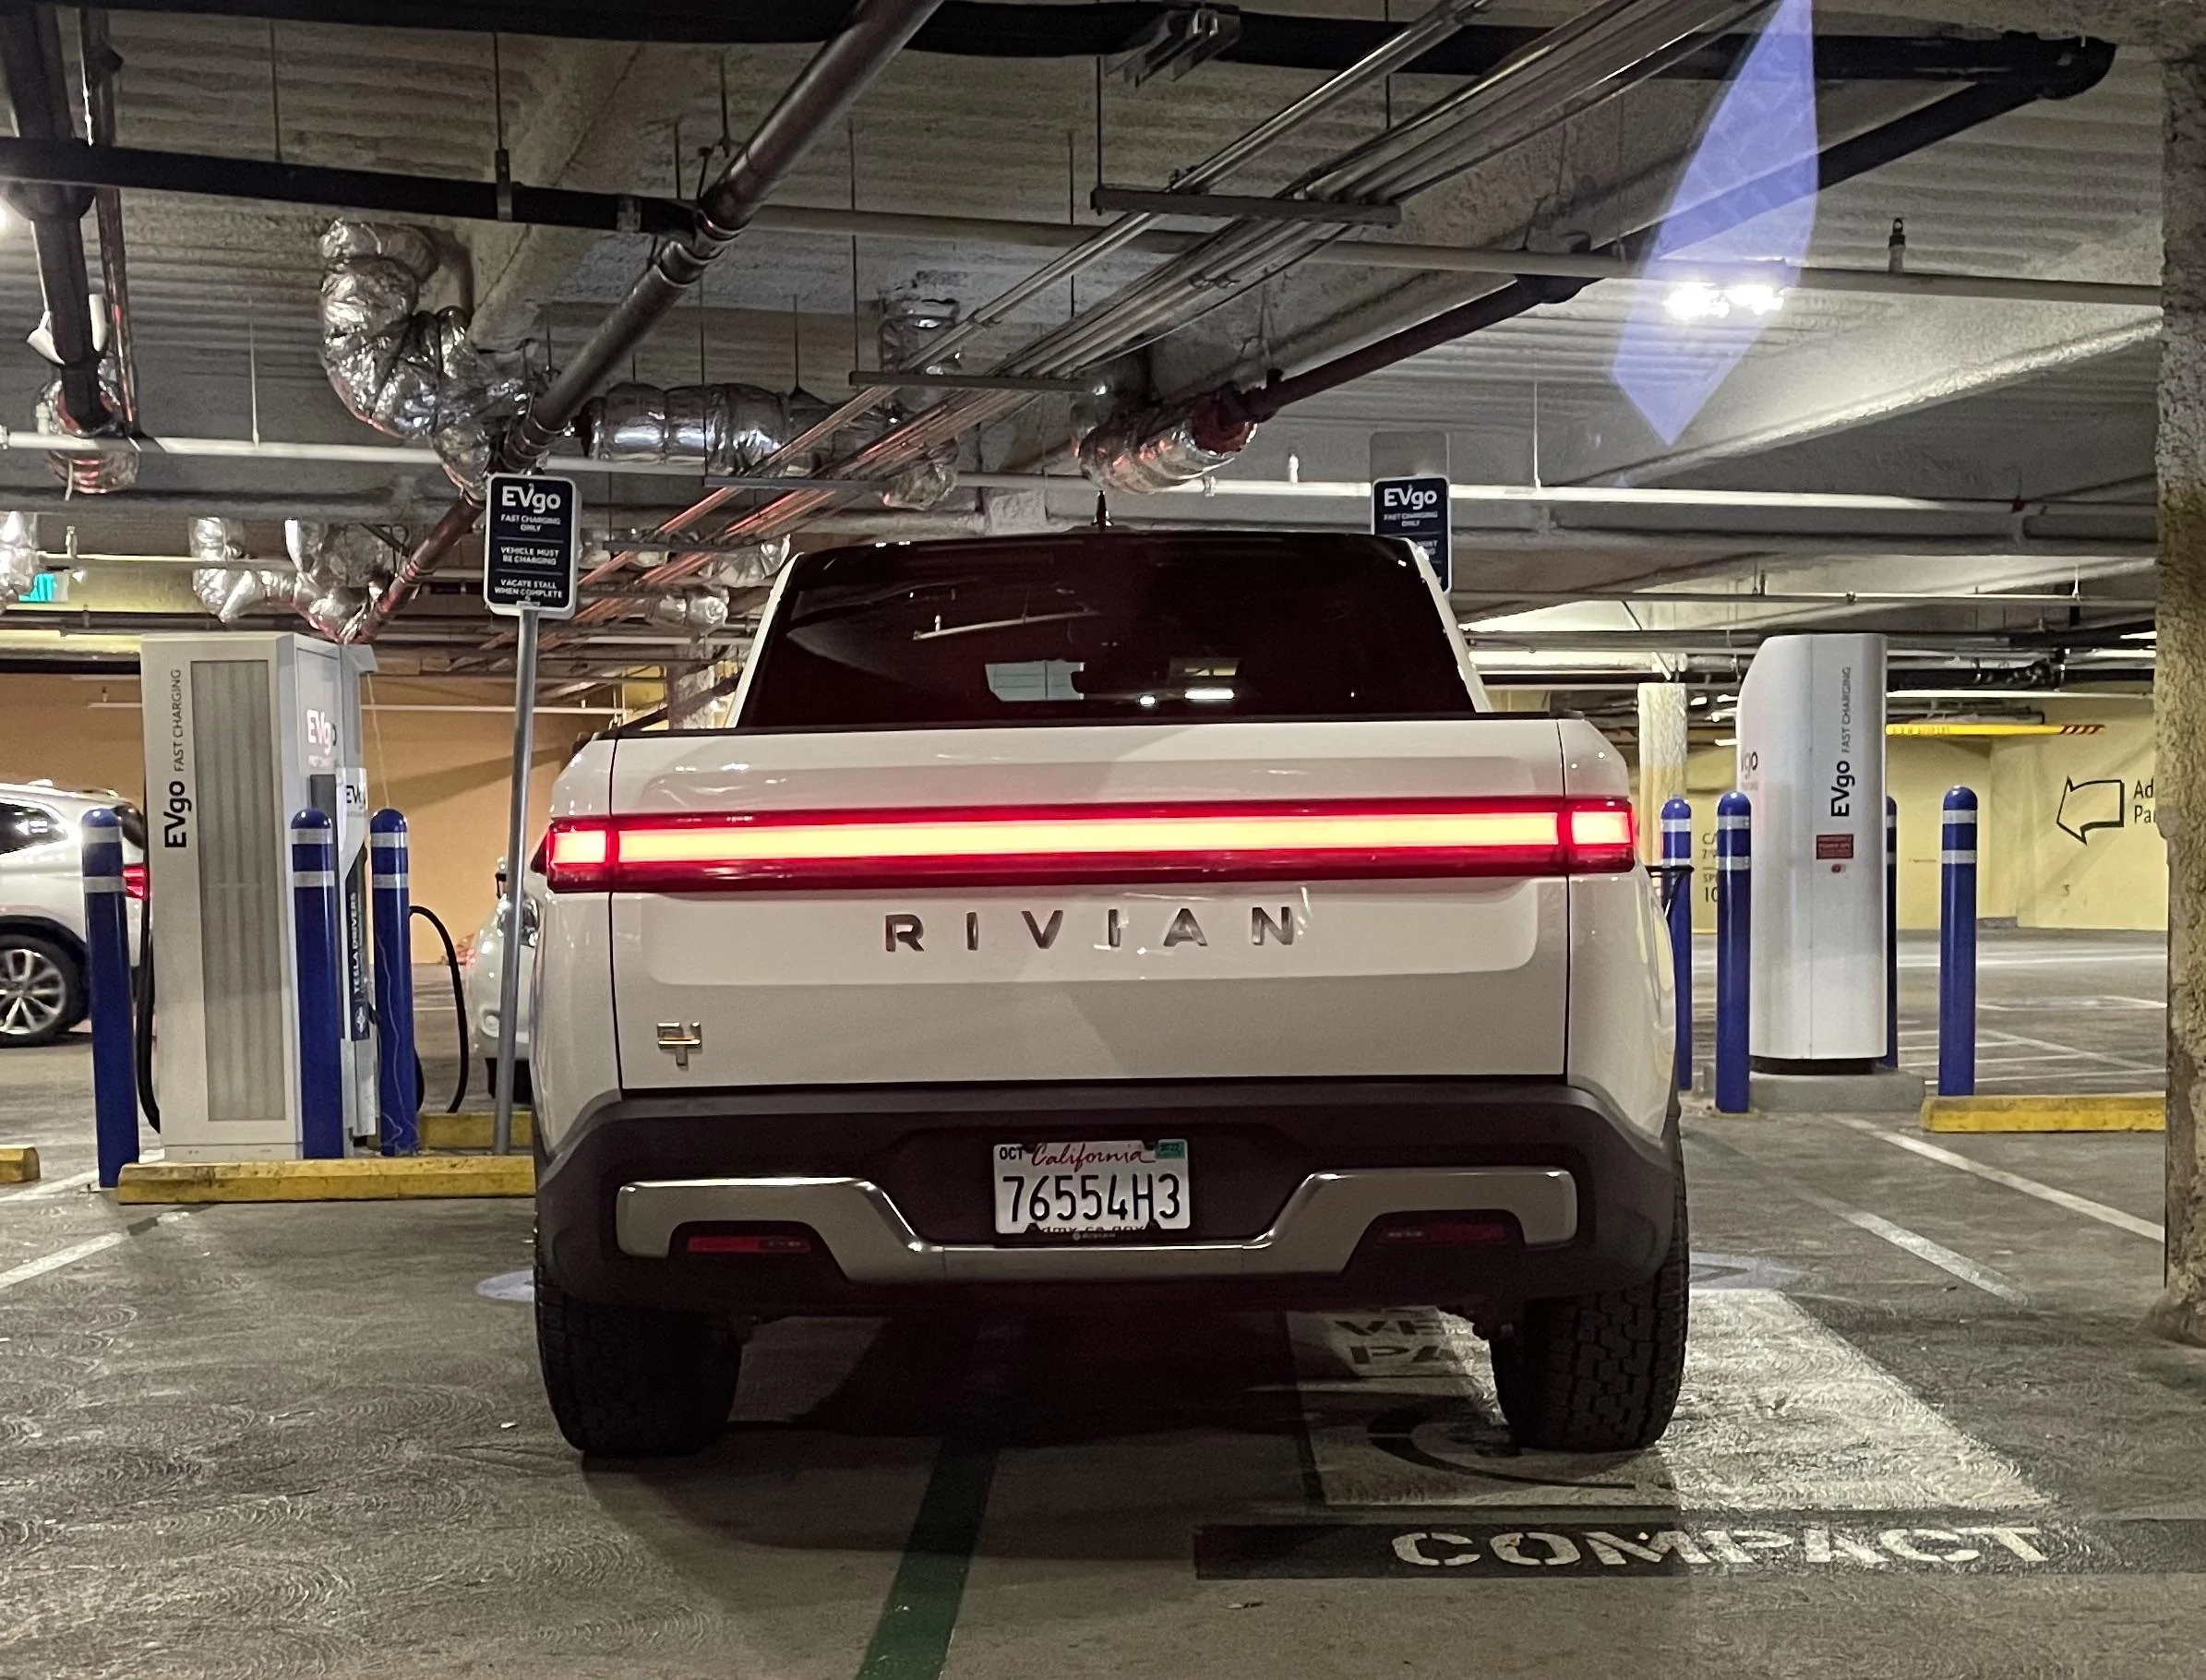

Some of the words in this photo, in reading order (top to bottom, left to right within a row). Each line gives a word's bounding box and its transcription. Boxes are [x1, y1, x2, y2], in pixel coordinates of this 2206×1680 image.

[501, 485, 561, 514] EVgo
[1385, 486, 1437, 510] EVgo
[501, 514, 520, 522] FAST
[500, 546, 534, 556] VEHICLE
[537, 549, 559, 558] MUST
[514, 556, 557, 566] CHARGING
[495, 587, 519, 595] WHEN
[520, 589, 562, 598] COMPLETE
[500, 579, 532, 588] VACATE
[534, 582, 557, 590] STALL
[171, 669, 184, 738] CHARGING
[1841, 667, 1851, 725] CHARGING
[1841, 727, 1850, 753] FAST
[174, 742, 185, 772] FAST
[1831, 761, 1855, 817] EVgo
[163, 781, 192, 847] EVgo
[885, 906, 1294, 952] RIVIAN
[1000, 1146, 1023, 1160] OCT
[1031, 1143, 1157, 1172] California
[1002, 1173, 1180, 1222] 76554H3
[1391, 1527, 2048, 1566] COMPACT
